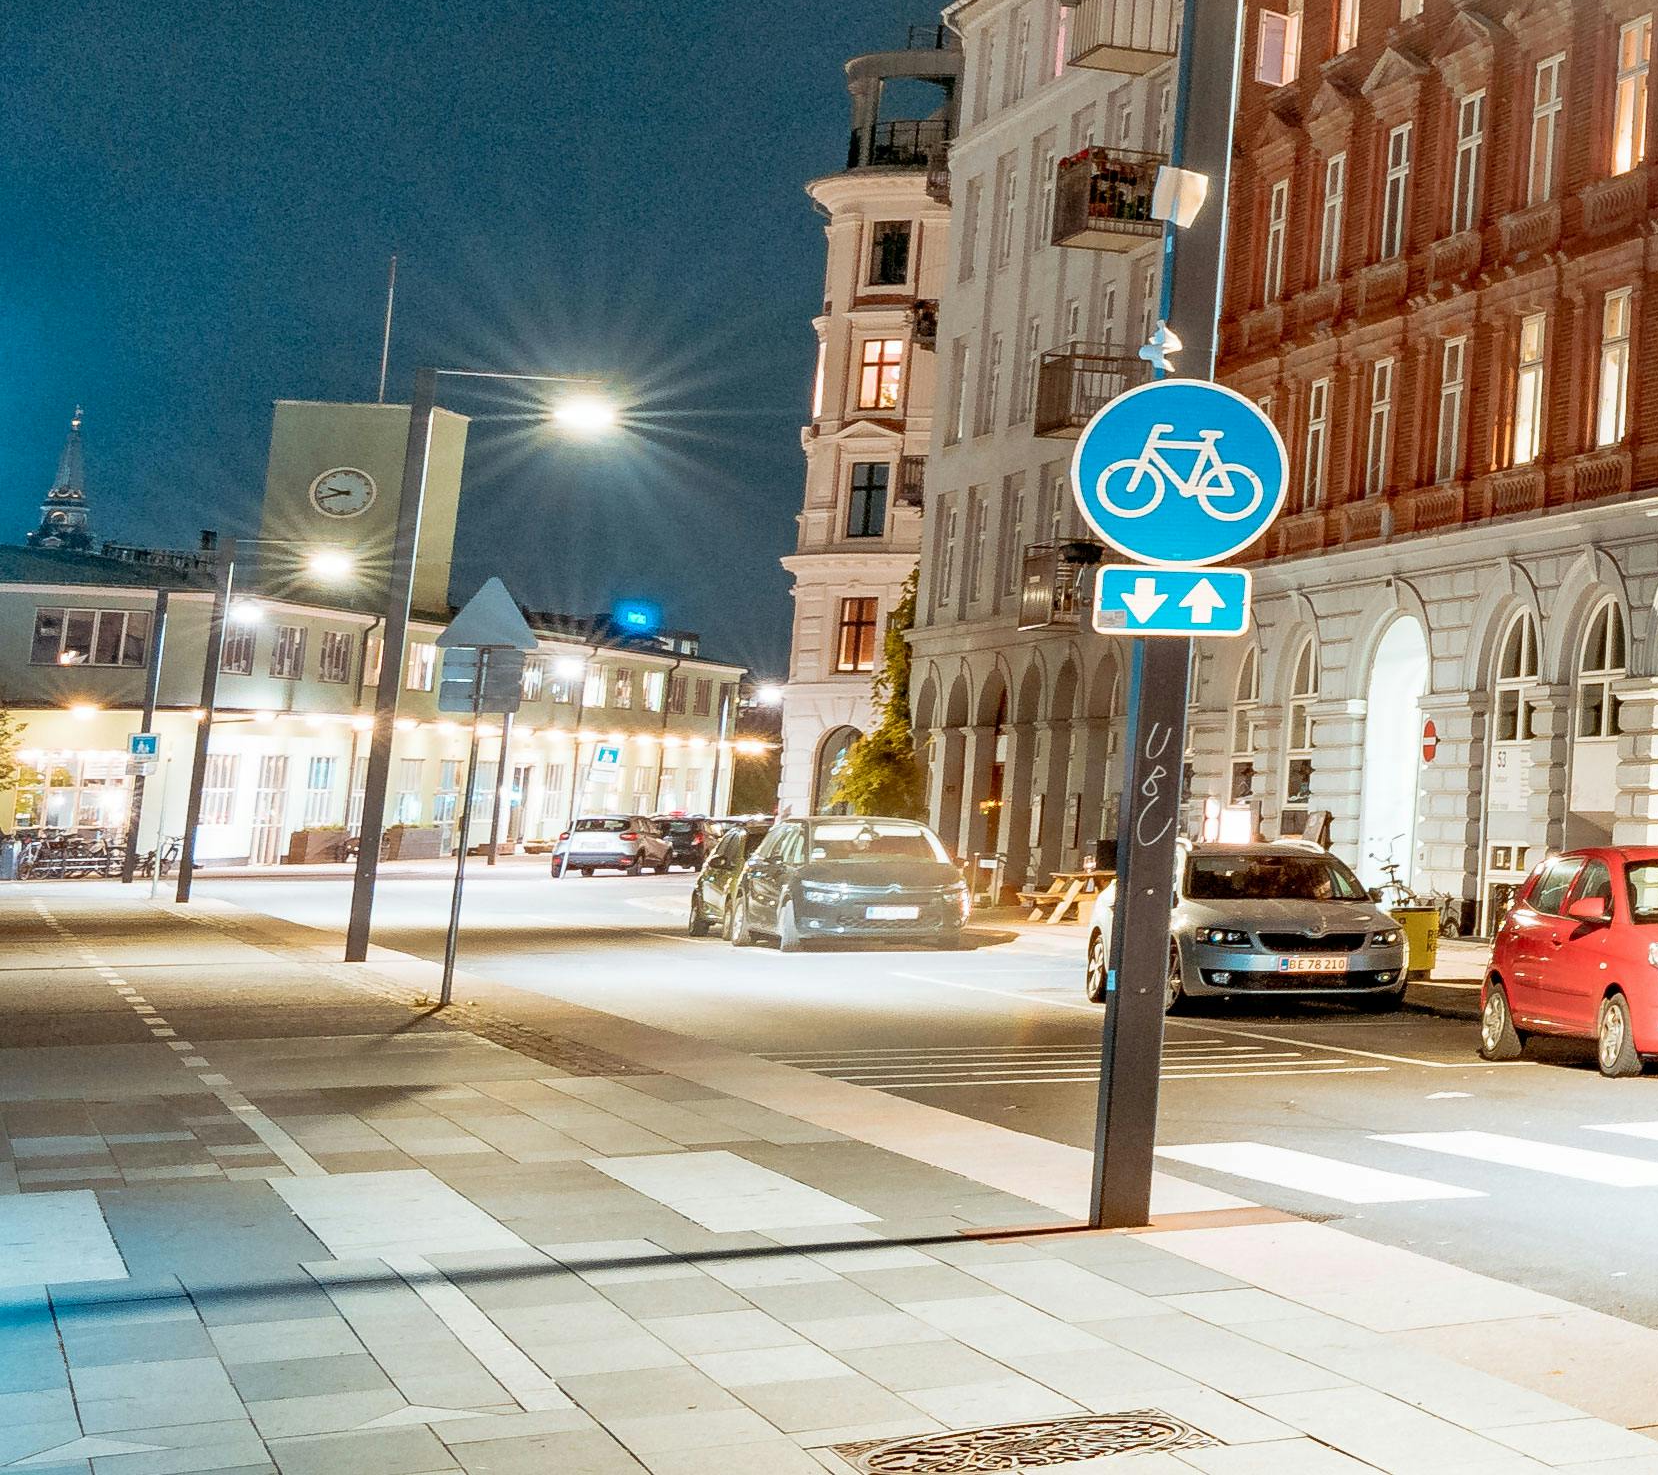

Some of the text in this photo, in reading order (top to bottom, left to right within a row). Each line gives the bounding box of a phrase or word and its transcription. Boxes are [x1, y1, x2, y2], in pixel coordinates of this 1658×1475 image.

[1289, 959, 1345, 970] BE 78 210
